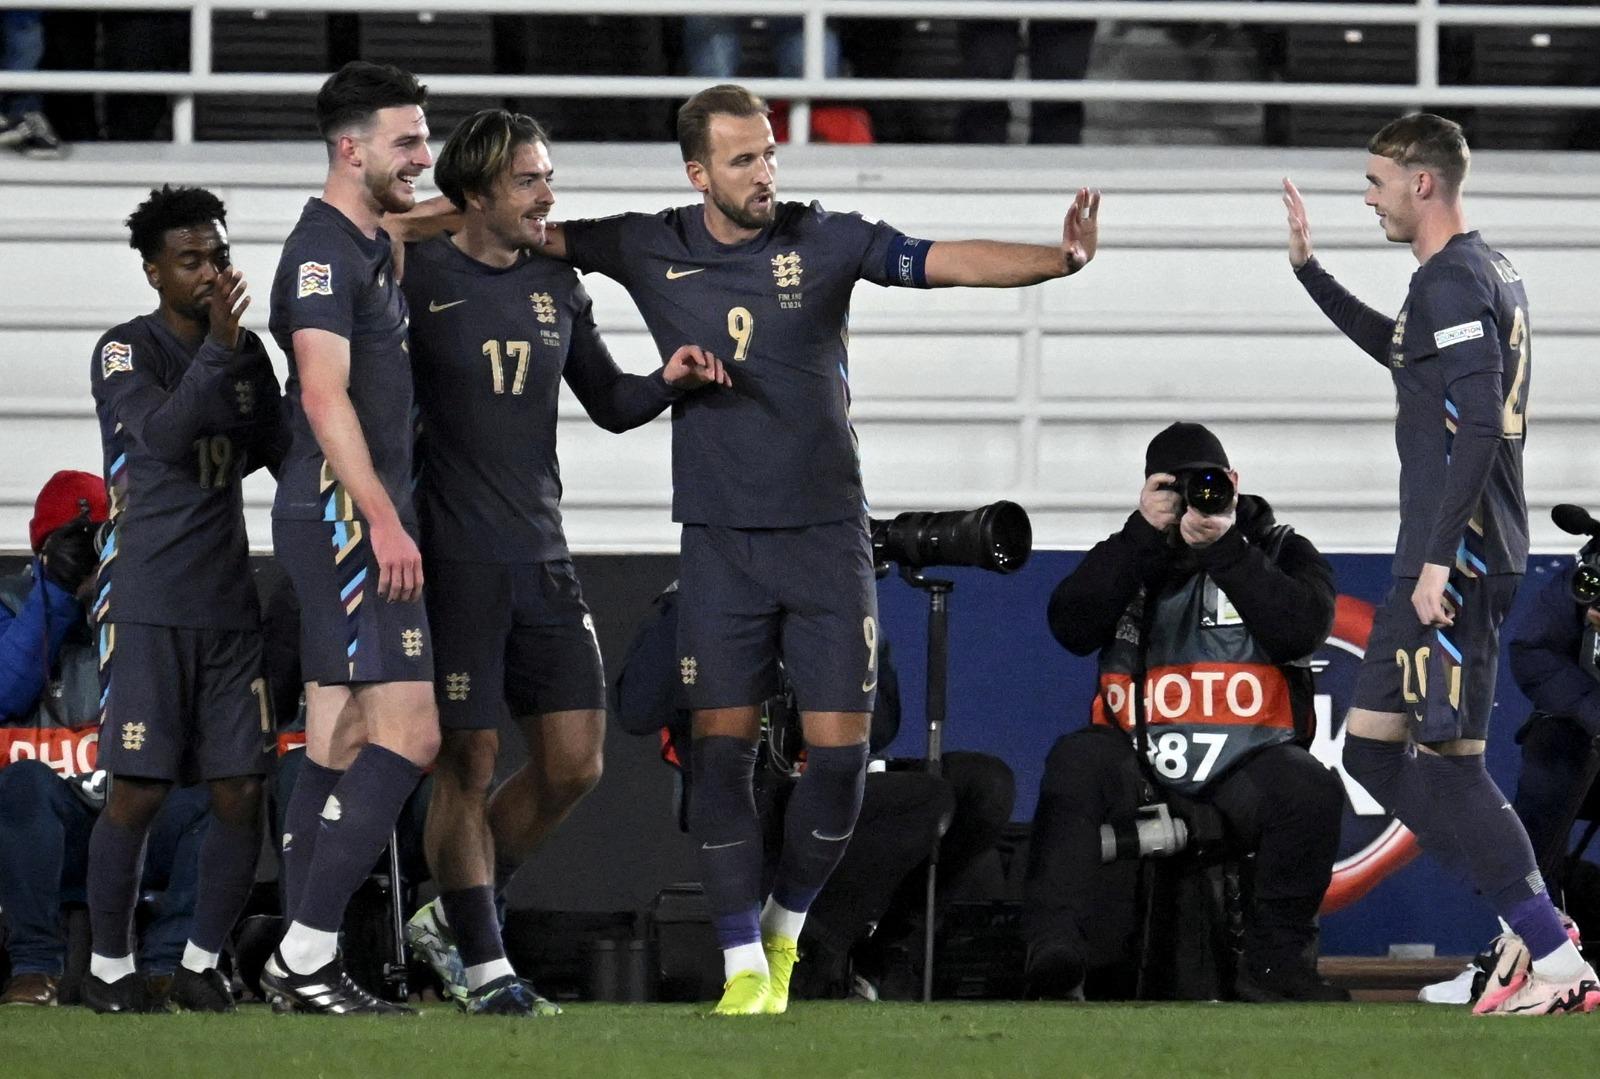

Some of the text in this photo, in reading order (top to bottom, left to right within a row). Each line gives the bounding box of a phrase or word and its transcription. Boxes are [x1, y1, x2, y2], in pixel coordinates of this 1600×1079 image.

[726, 306, 754, 362] 9
[482, 339, 531, 395] 17
[192, 434, 233, 489] 19
[863, 616, 878, 671] 9
[1107, 671, 1264, 726] PHOTO
